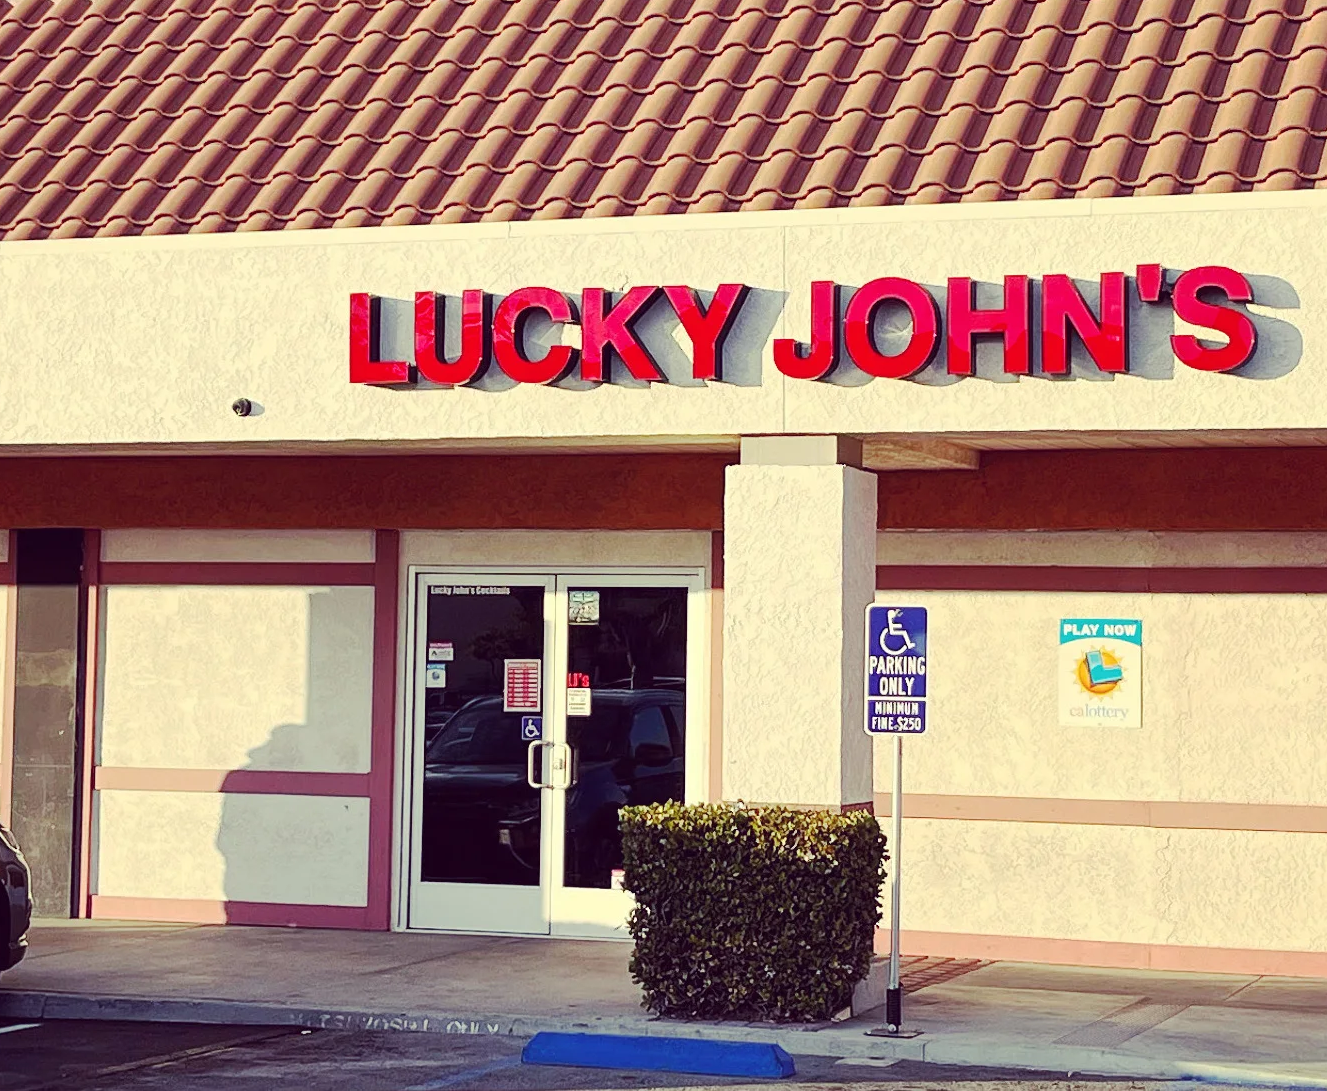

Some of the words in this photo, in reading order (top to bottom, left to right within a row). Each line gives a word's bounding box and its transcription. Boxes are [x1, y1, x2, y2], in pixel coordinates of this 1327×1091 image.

[349, 285, 749, 385] LUCKY
[772, 263, 1255, 386] JOHN'S
[1063, 623, 1100, 636] PLAY
[1103, 623, 1137, 636] NOW
[869, 655, 926, 676] PARKING
[879, 676, 915, 696] ONLY
[874, 701, 919, 715] MINIMUM
